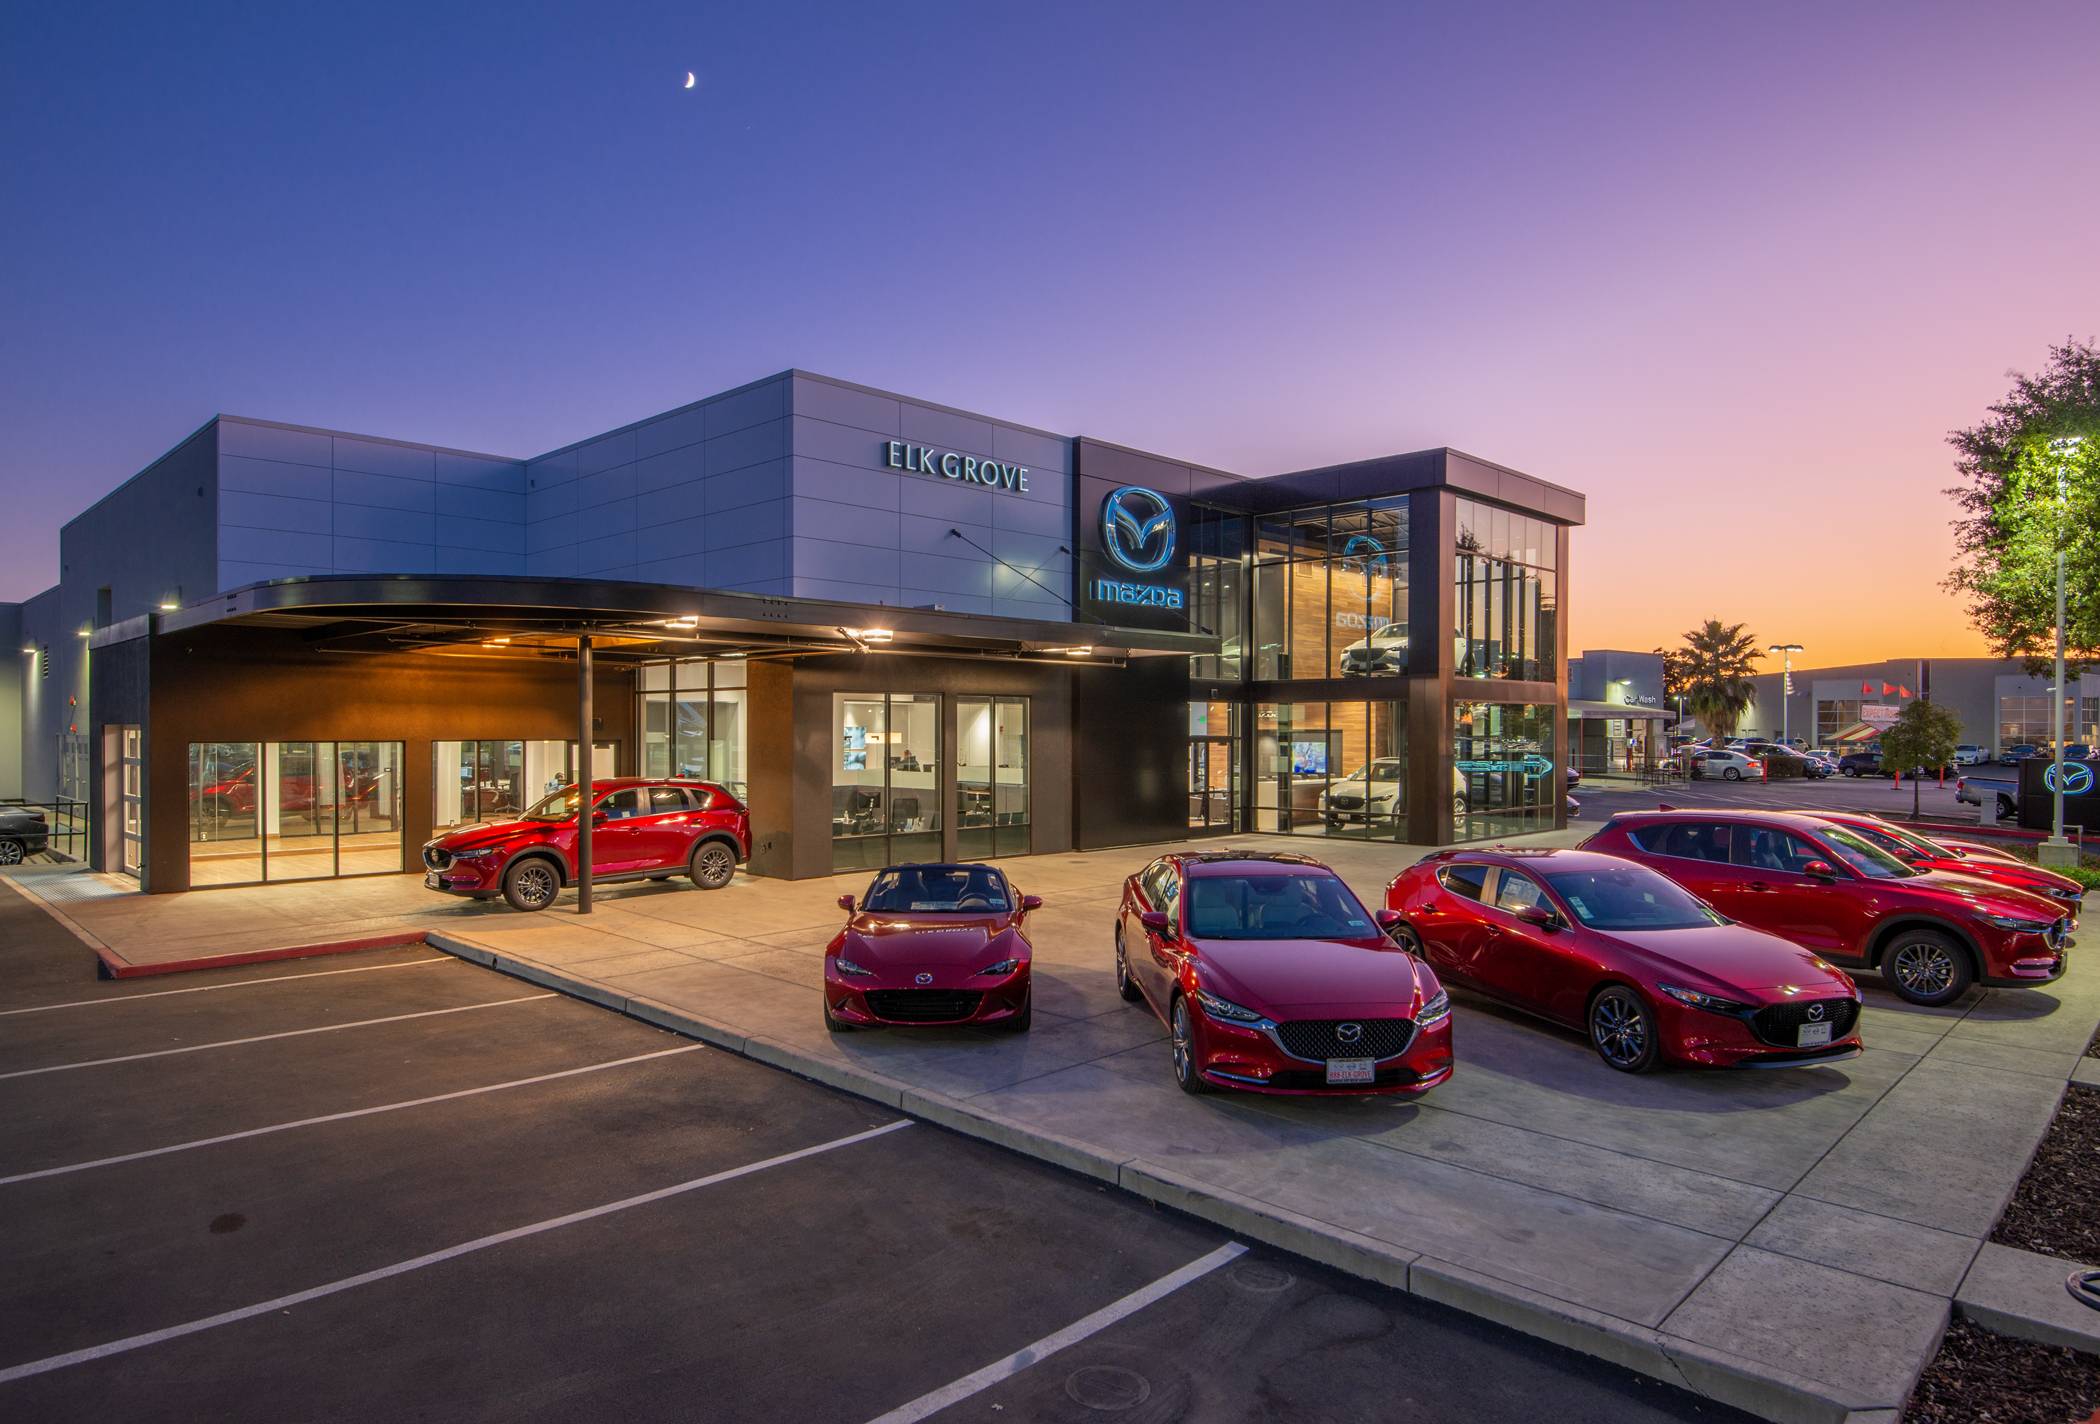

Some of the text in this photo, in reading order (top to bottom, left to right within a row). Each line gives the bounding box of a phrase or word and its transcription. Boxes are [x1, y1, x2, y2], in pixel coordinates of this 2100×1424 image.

[888, 440, 1030, 493] ELK GROVE
[1639, 695, 1656, 704] Wash
